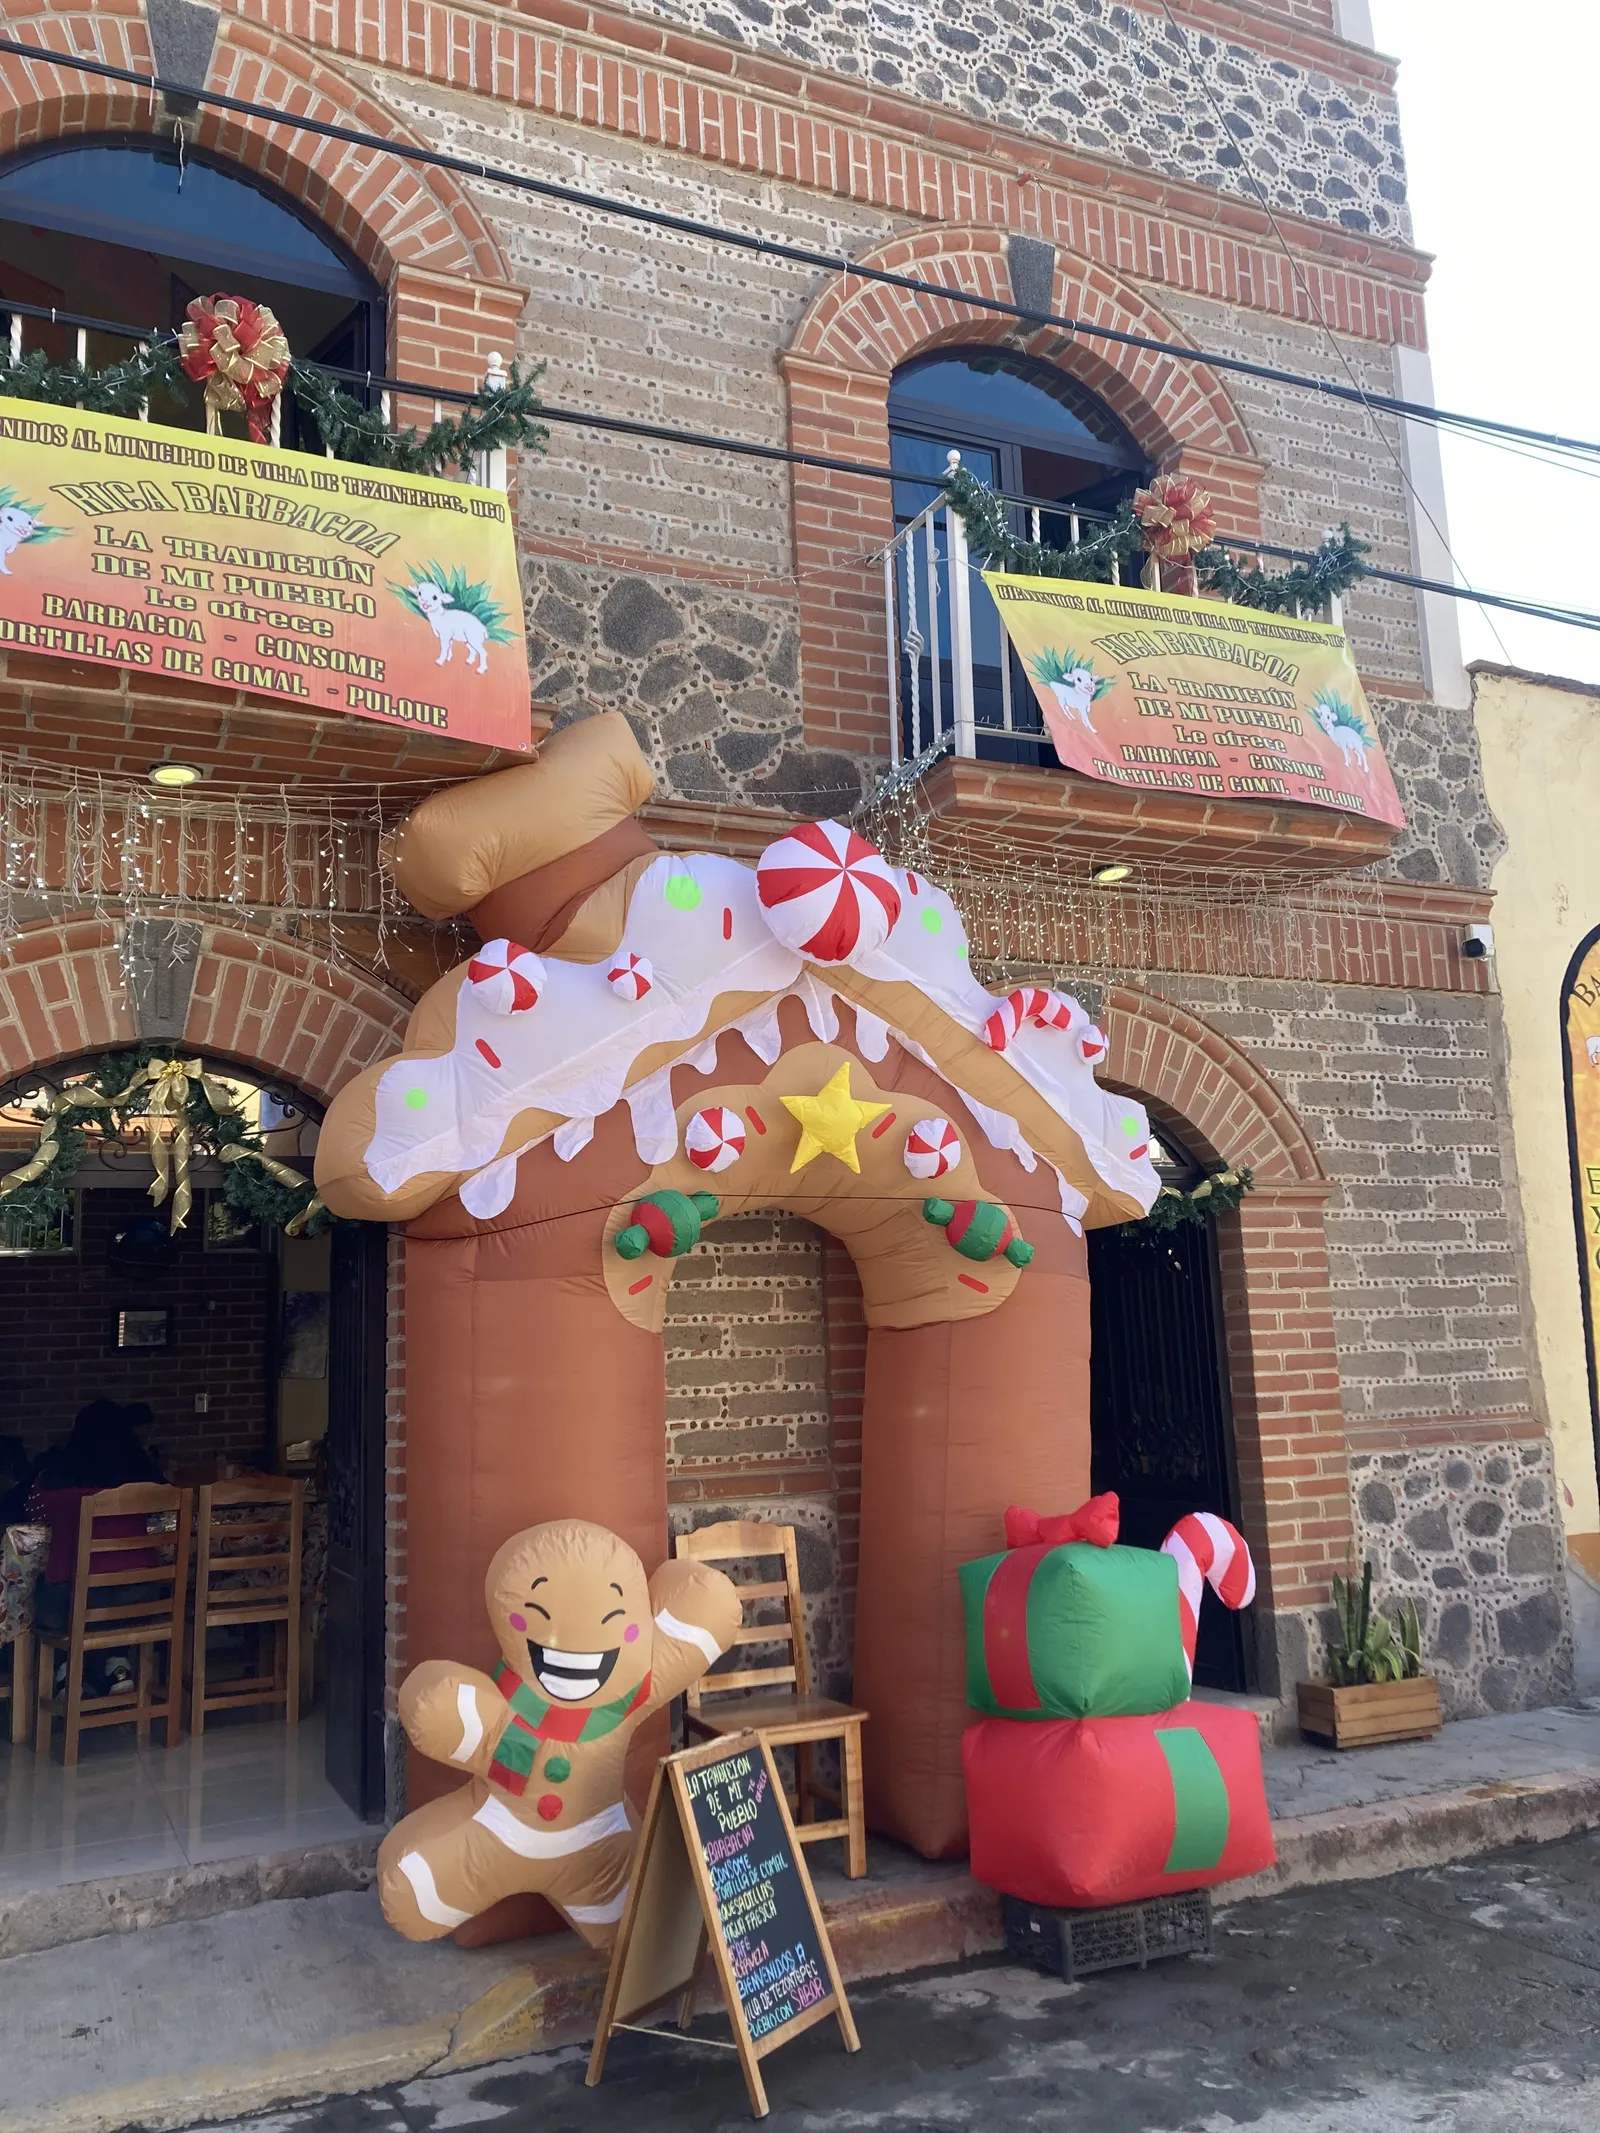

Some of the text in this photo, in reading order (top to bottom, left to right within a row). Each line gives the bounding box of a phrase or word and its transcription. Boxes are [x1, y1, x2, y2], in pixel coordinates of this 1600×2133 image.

[0, 416, 505, 523] NIDOS AL MUNICIPIO DE VILLA DE TEZONTEPEC, HGO
[50, 481, 401, 558] RICA BARBACOA
[94, 525, 374, 587] LA TRADICIÓN
[91, 553, 376, 618] DE MI PUEBLO
[145, 585, 333, 638] Le ofrece
[996, 585, 1084, 611] BIENVENIDOS
[1086, 597, 1104, 614] AL
[1104, 600, 1172, 623] MUNICIPIO
[1172, 609, 1192, 625] DE
[1192, 612, 1230, 631] VILLA
[1230, 618, 1248, 633] DE
[42, 593, 206, 643] BARBACOA
[256, 634, 385, 682] CONSOME
[1091, 631, 1300, 687] RICA BARBACOA
[161, 646, 204, 675] DE
[212, 656, 309, 697] COMAL
[347, 683, 448, 729] PULQUE
[1127, 672, 1297, 709] LA TRADICIÓN
[1134, 697, 1303, 736] DE MI PUEBLO
[1173, 724, 1287, 753] Le ofrece
[1092, 758, 1194, 788] TORTILLAS
[1197, 774, 1224, 792] DE
[1228, 776, 1290, 795] COMAL
[1309, 785, 1365, 812] PULQUE
[1120, 745, 1220, 768] BARBACOA
[1249, 753, 1325, 780] CONSOME
[1572, 970, 1600, 1007] BA
[685, 1755, 751, 1800] LA TRADICION
[706, 1780, 743, 1816] DE MI
[717, 1797, 758, 1833] PUEBLO
[749, 1867, 760, 1885] DE
[759, 1851, 788, 1879] COMAL
[727, 1899, 777, 1942] AGUA FRESCA
[735, 1941, 769, 1978] CERVEZA
[737, 1941, 806, 1999] BIENVENIDOS A
[760, 1990, 773, 2010] DE
[769, 1959, 818, 2003] TEZONTEPEC
[775, 2000, 794, 2022] CON
[790, 1977, 826, 2012] SABOR
